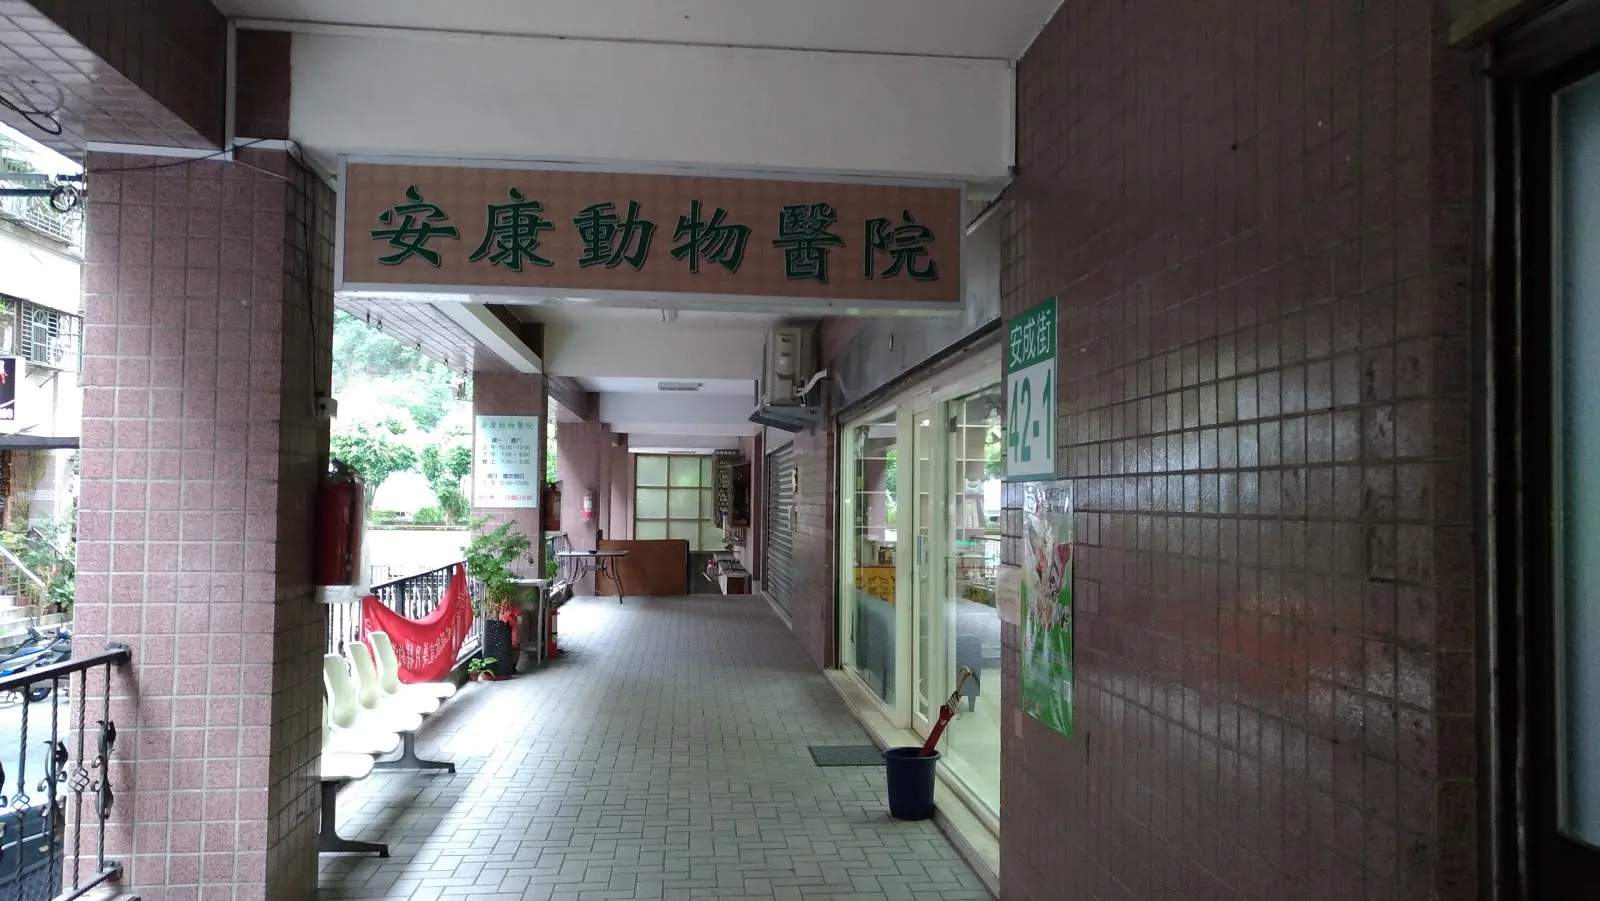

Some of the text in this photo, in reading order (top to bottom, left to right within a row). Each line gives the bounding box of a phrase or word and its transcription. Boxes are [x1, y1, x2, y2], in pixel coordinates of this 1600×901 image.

[370, 184, 938, 283] 安康動物醫院
[1010, 309, 1051, 368] 安成街
[1009, 369, 1051, 463] 42-1
